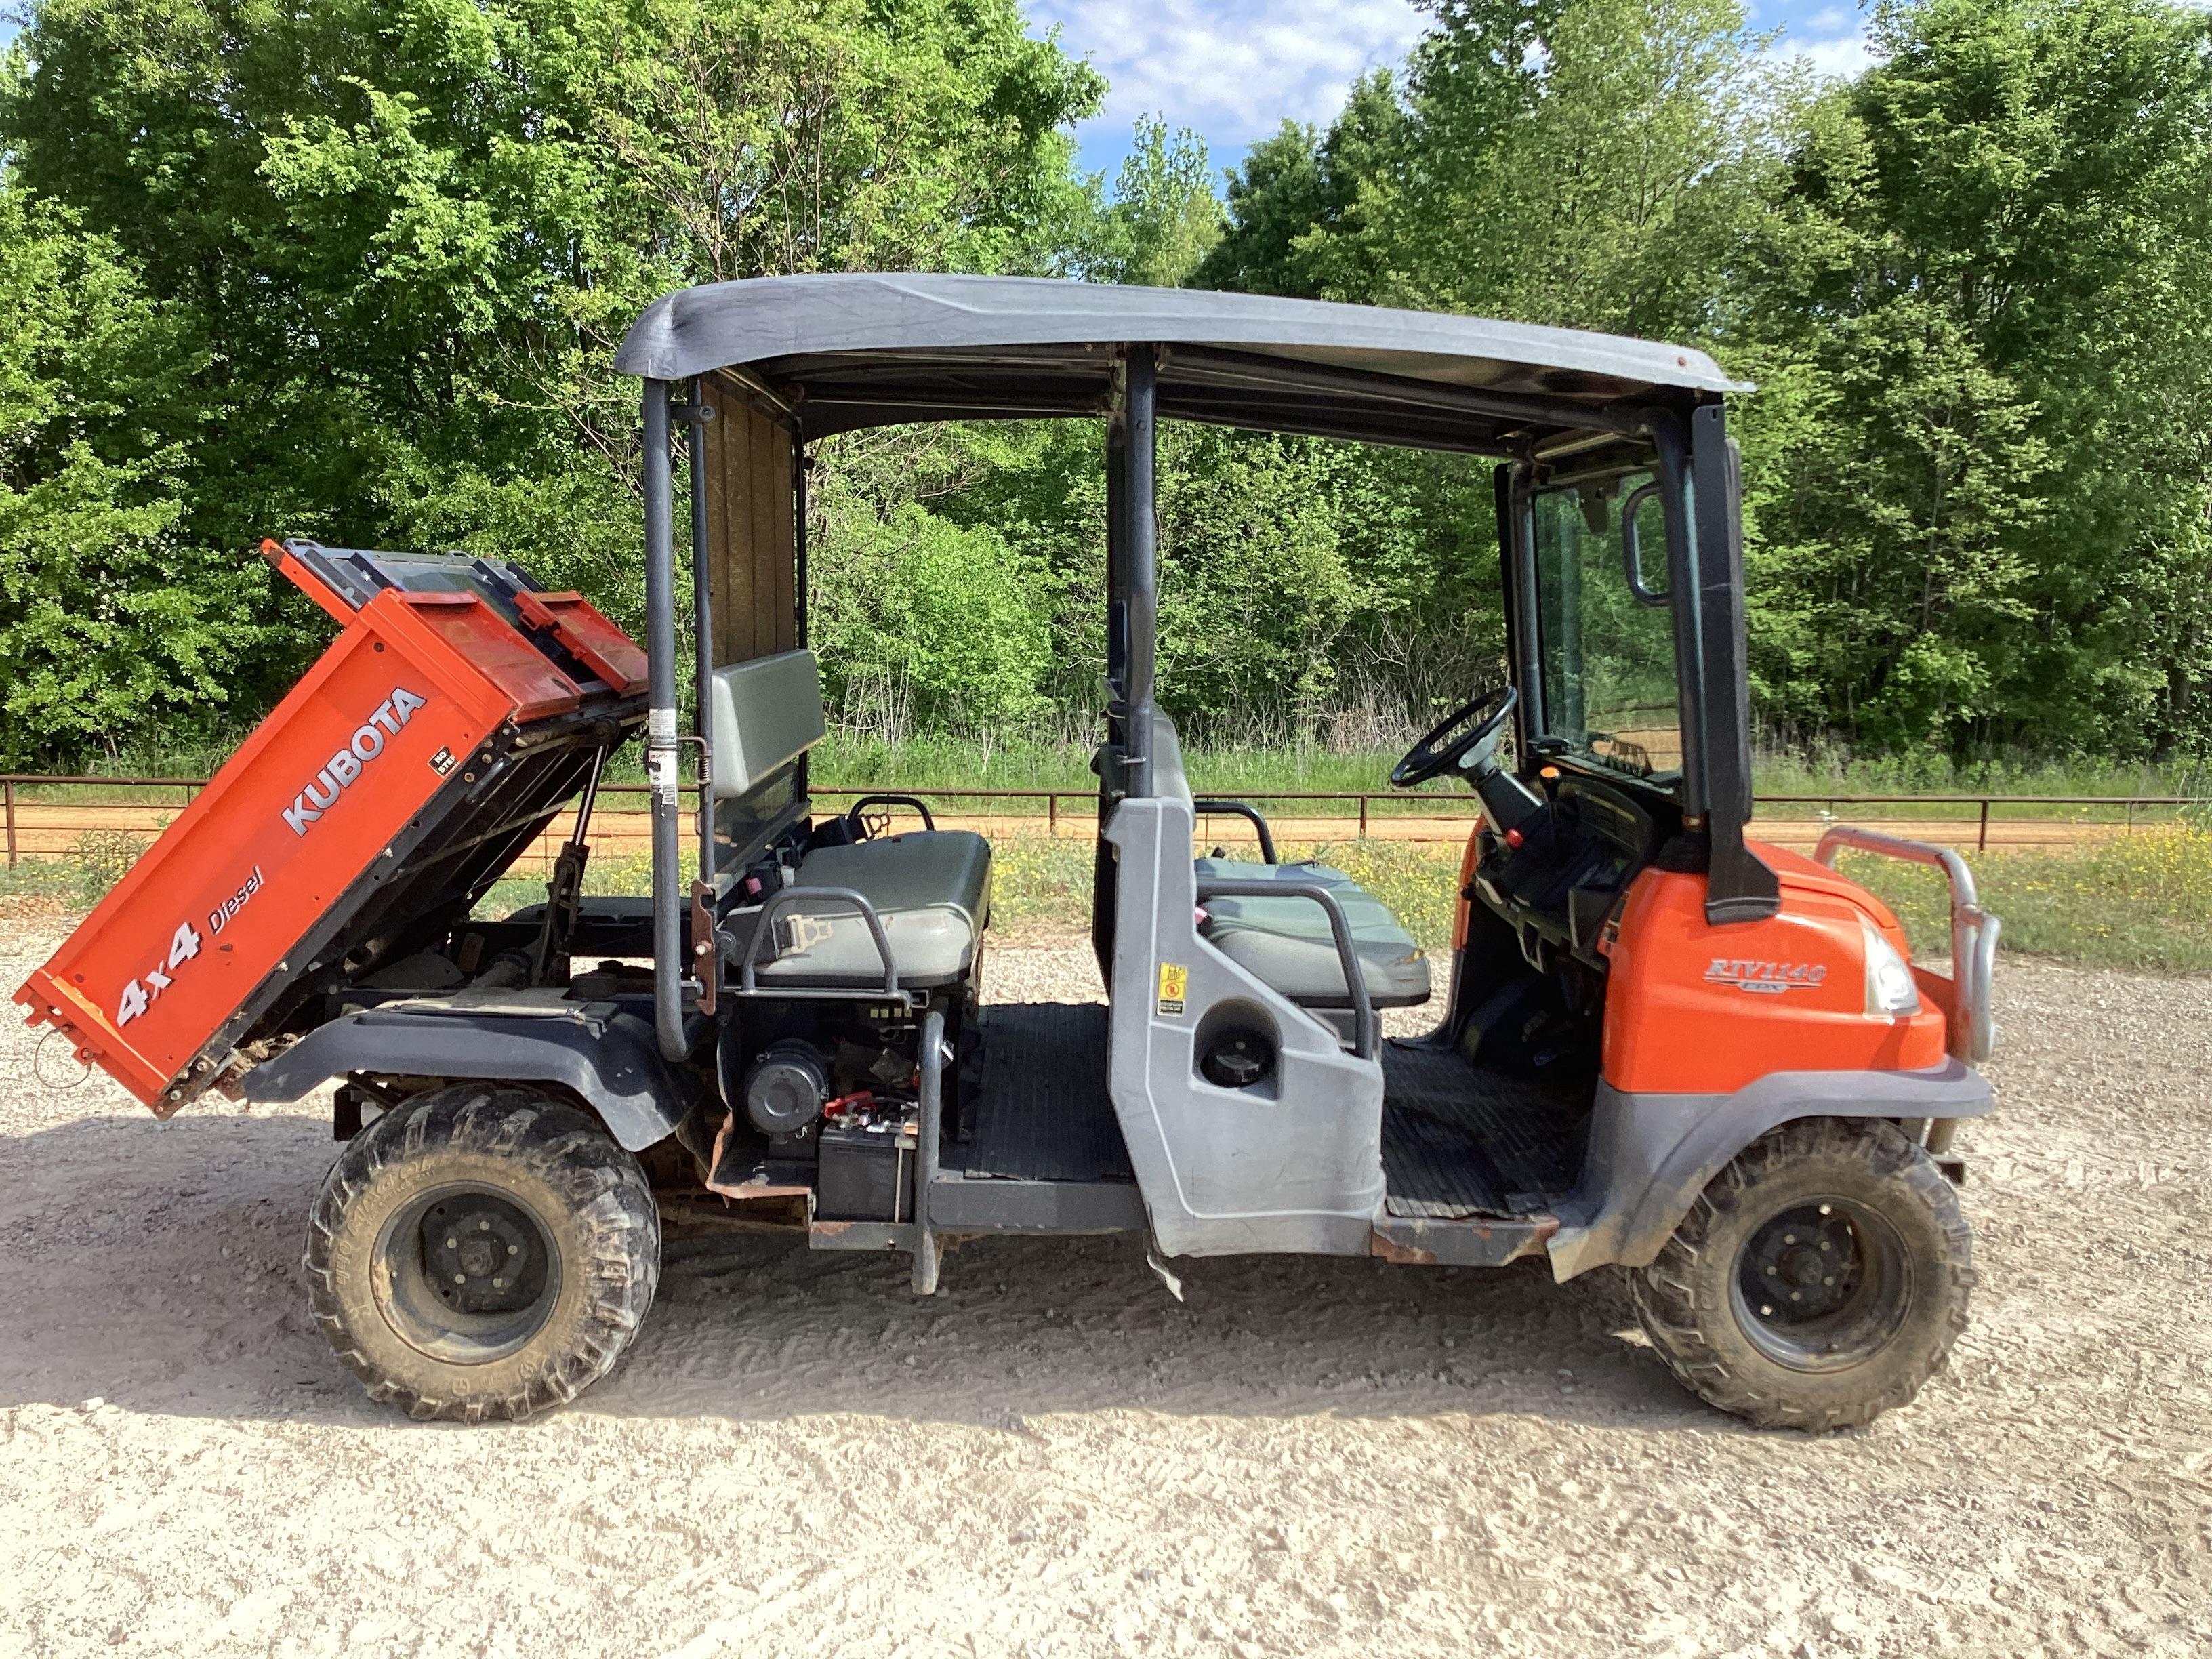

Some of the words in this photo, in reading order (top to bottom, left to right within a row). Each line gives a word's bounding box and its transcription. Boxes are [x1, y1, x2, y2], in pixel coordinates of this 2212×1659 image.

[281, 687, 428, 838] KUBOTA
[434, 751, 447, 764] NO
[438, 754, 455, 773] STEP
[116, 922, 203, 1027] 4x4
[207, 865, 264, 936] Diesel
[1704, 958, 1827, 982] RTV1140
